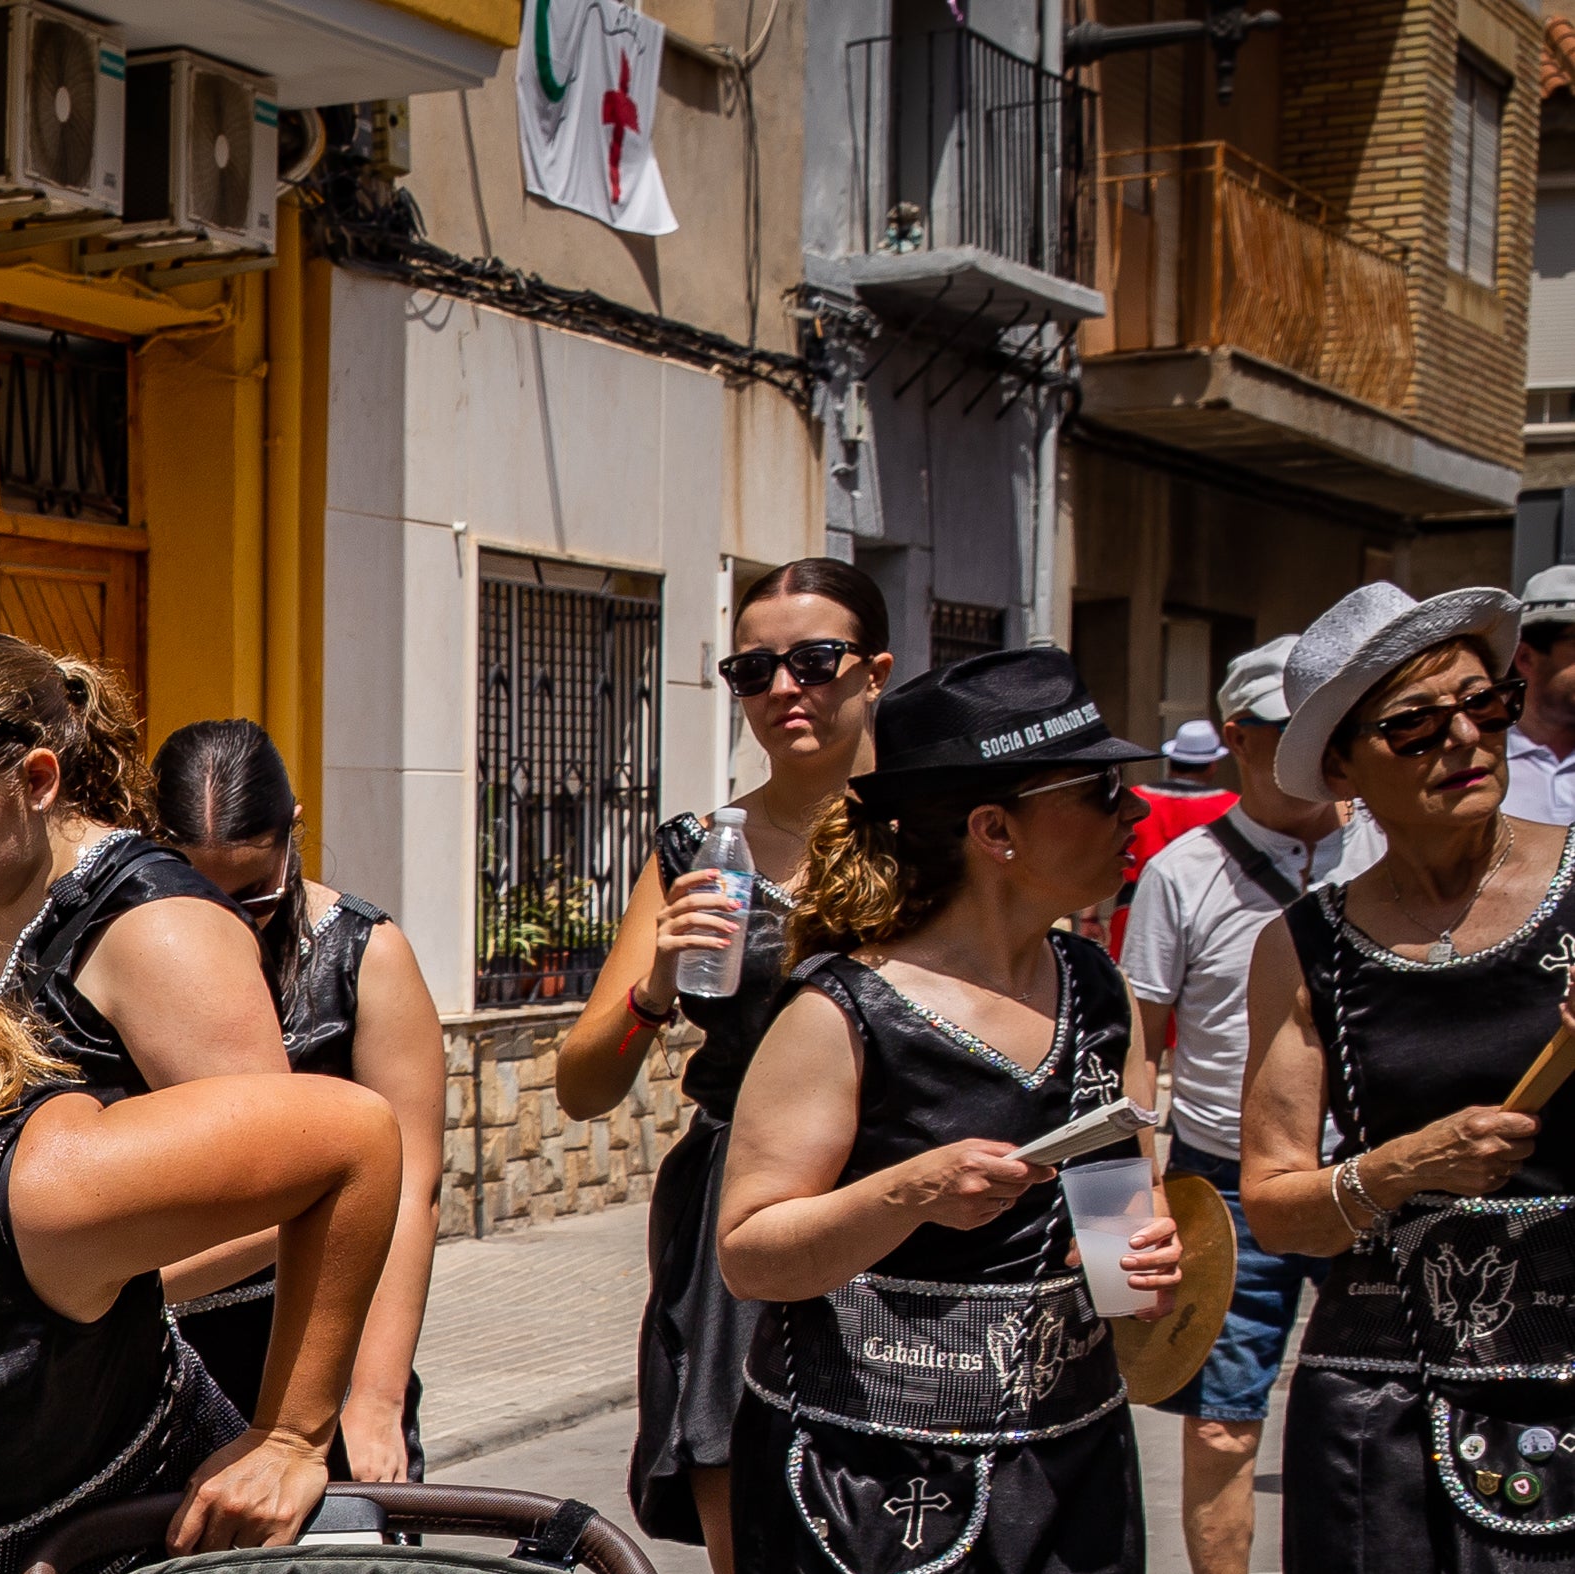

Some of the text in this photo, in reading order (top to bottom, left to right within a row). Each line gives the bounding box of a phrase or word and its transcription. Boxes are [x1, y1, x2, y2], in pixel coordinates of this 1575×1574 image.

[980, 730, 1025, 759] SOCIA
[1024, 723, 1045, 746] DE
[1043, 709, 1086, 739] HONOR
[863, 1336, 984, 1371] Caballeros
